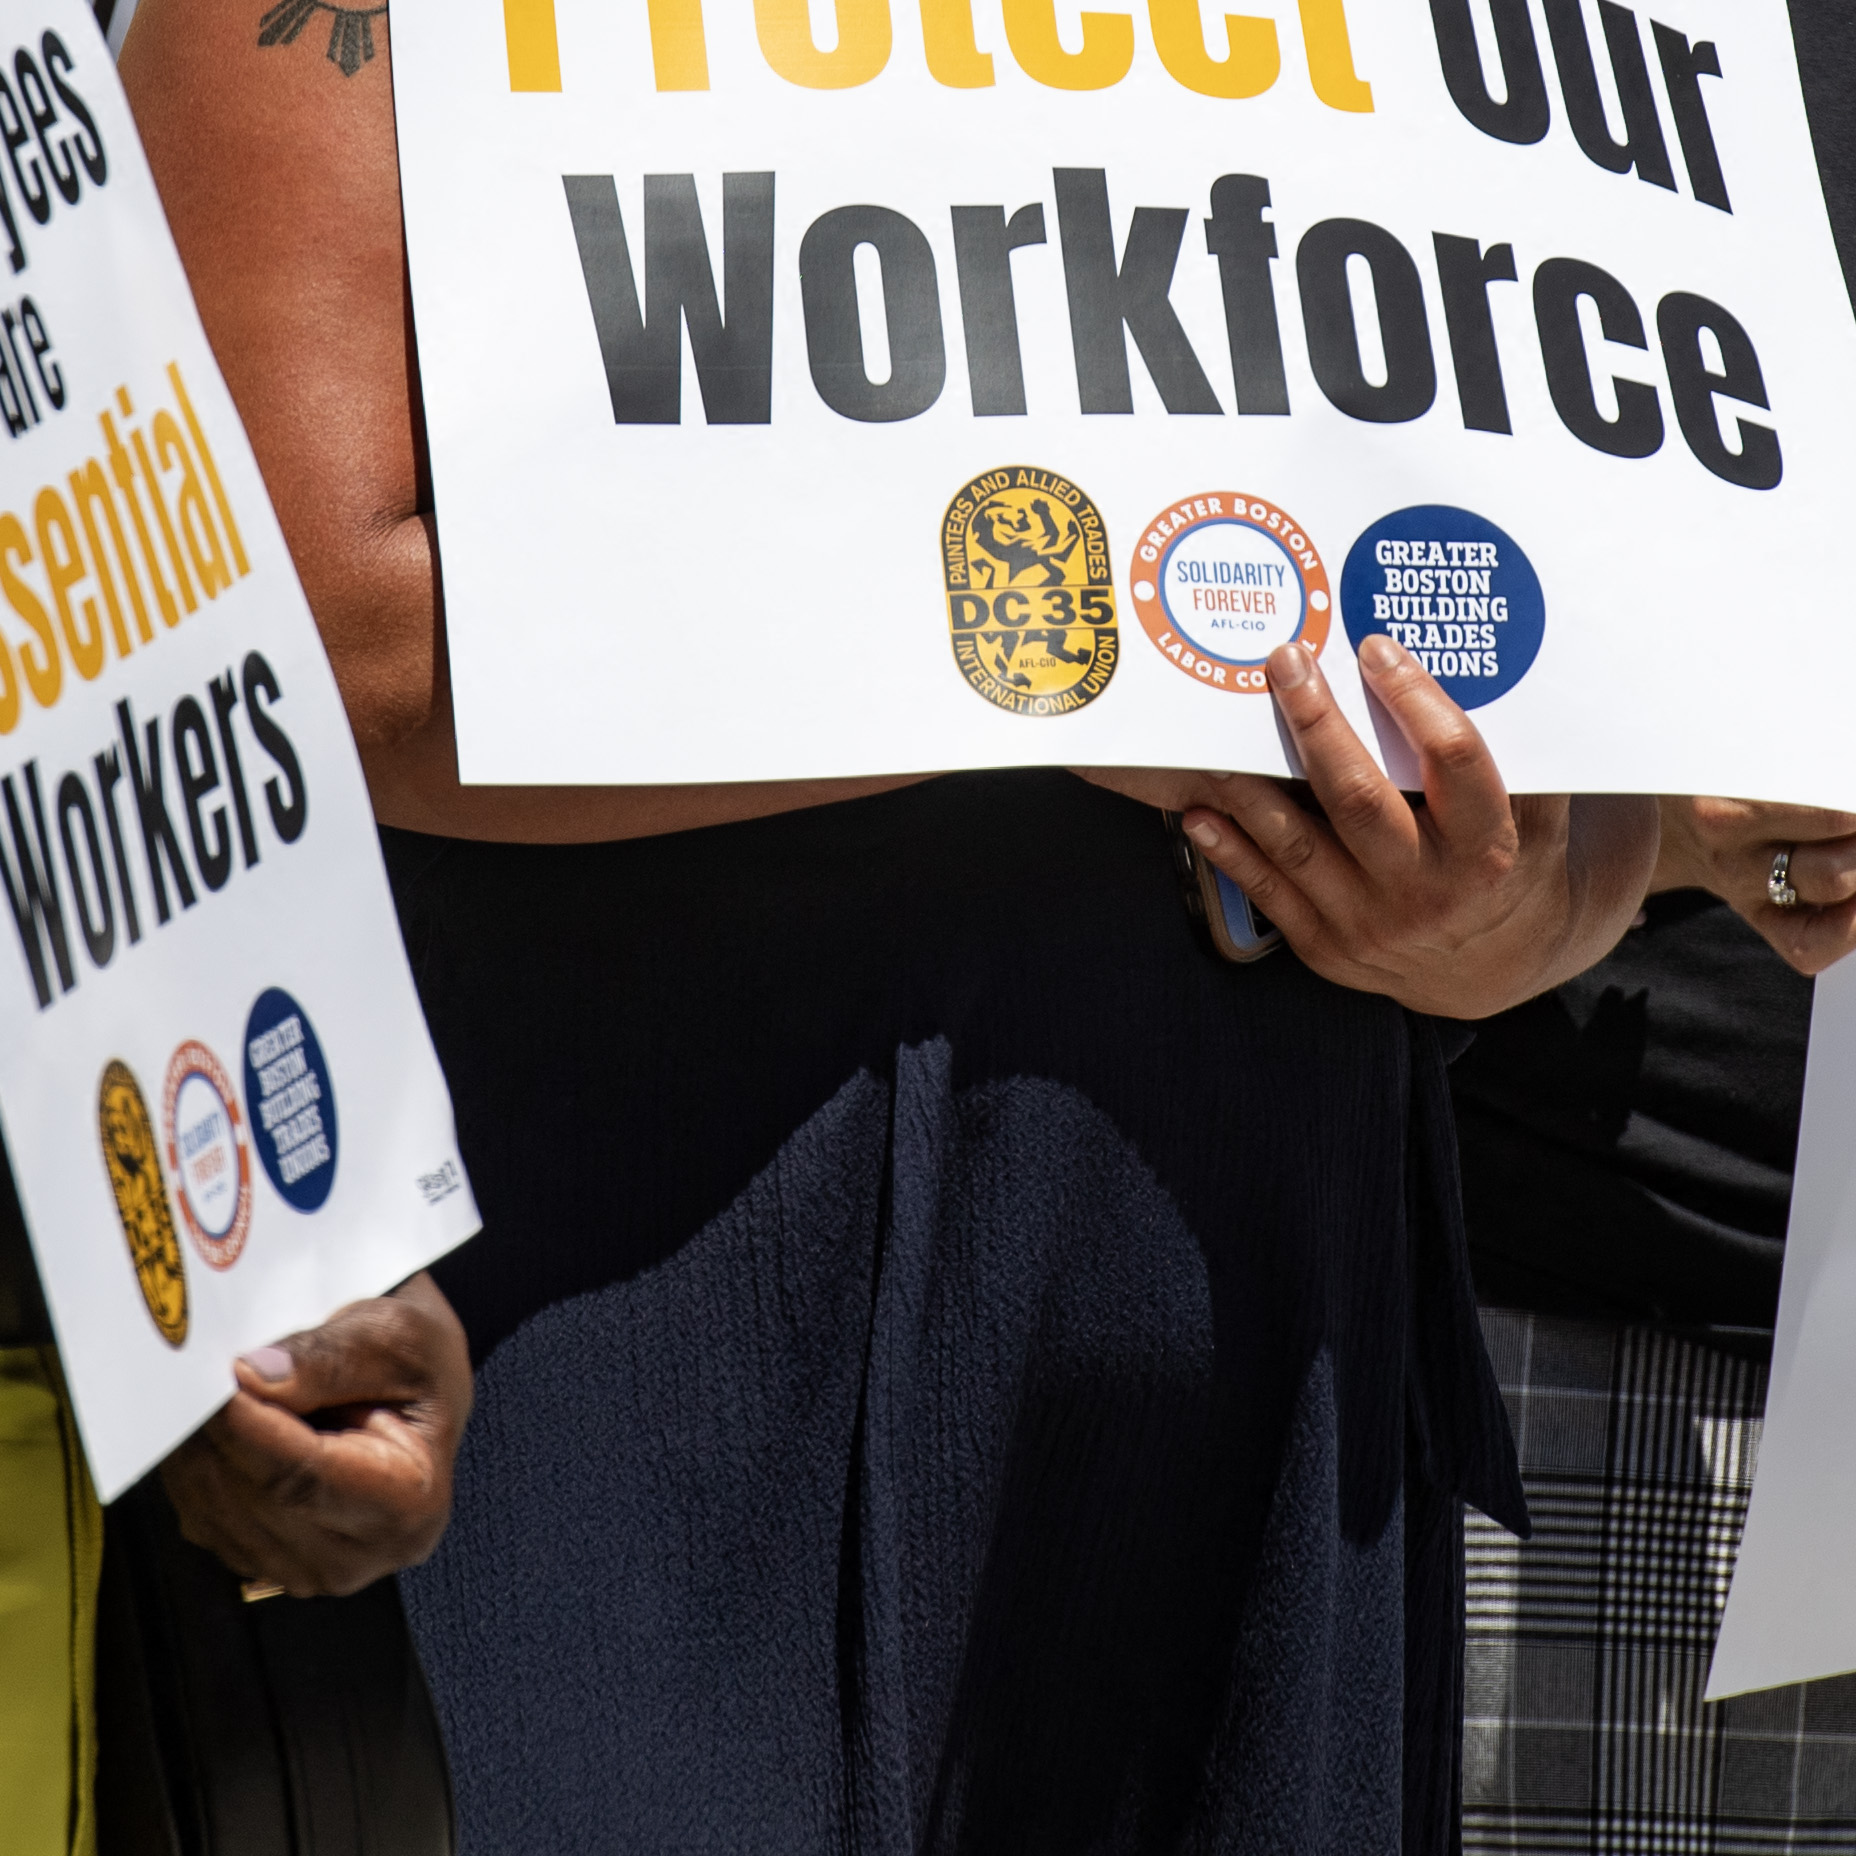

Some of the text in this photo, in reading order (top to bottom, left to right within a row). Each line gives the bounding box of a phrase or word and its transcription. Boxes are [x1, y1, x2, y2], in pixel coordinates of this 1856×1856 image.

[561, 167, 1783, 491] Workforce
[946, 469, 1108, 584] PAINTERS AND ALLIED TRADES
[1140, 497, 1318, 571] GREATER BOSTON
[1375, 540, 1498, 567] GREATER
[1176, 561, 1285, 587] SOLIDARITY
[1384, 568, 1491, 594] BOSTON
[949, 589, 1114, 630] DC 35
[1193, 588, 1276, 614] FOREVER
[1373, 594, 1508, 622] BUILDING
[1211, 619, 1265, 631] AFL-CIO
[1387, 622, 1496, 649] TRADES
[1019, 657, 1056, 669] AFL-CIO
[1157, 632, 1226, 685] LABOR
[1410, 651, 1498, 676] NIONS
[957, 635, 1116, 714] INTERNATIONAL UNION
